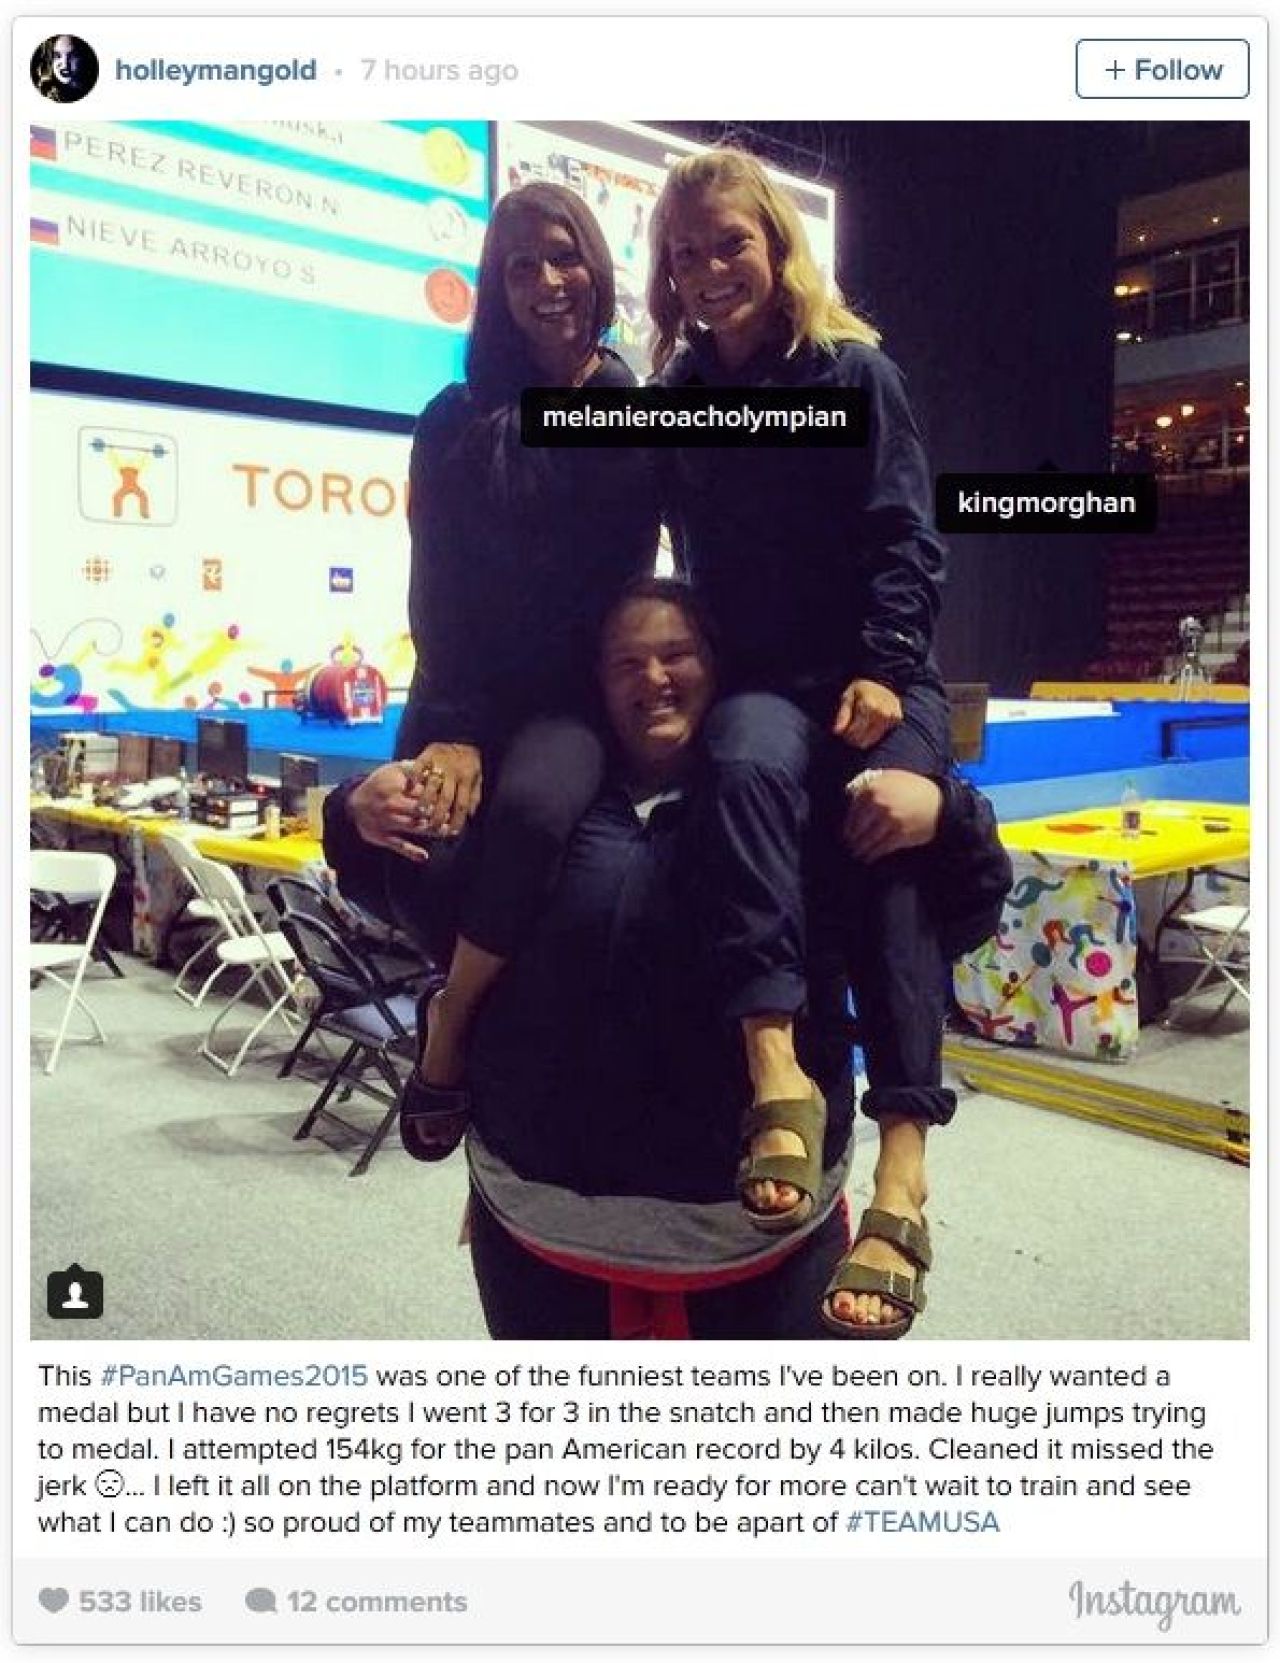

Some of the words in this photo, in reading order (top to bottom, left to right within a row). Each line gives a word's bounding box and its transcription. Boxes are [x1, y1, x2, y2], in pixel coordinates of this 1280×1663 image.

[64, 131, 168, 174] PEREZ
[177, 158, 313, 209] REVERON
[68, 214, 158, 252] NIEVE
[171, 238, 292, 278] ARROYO
[232, 464, 412, 519] TORO
